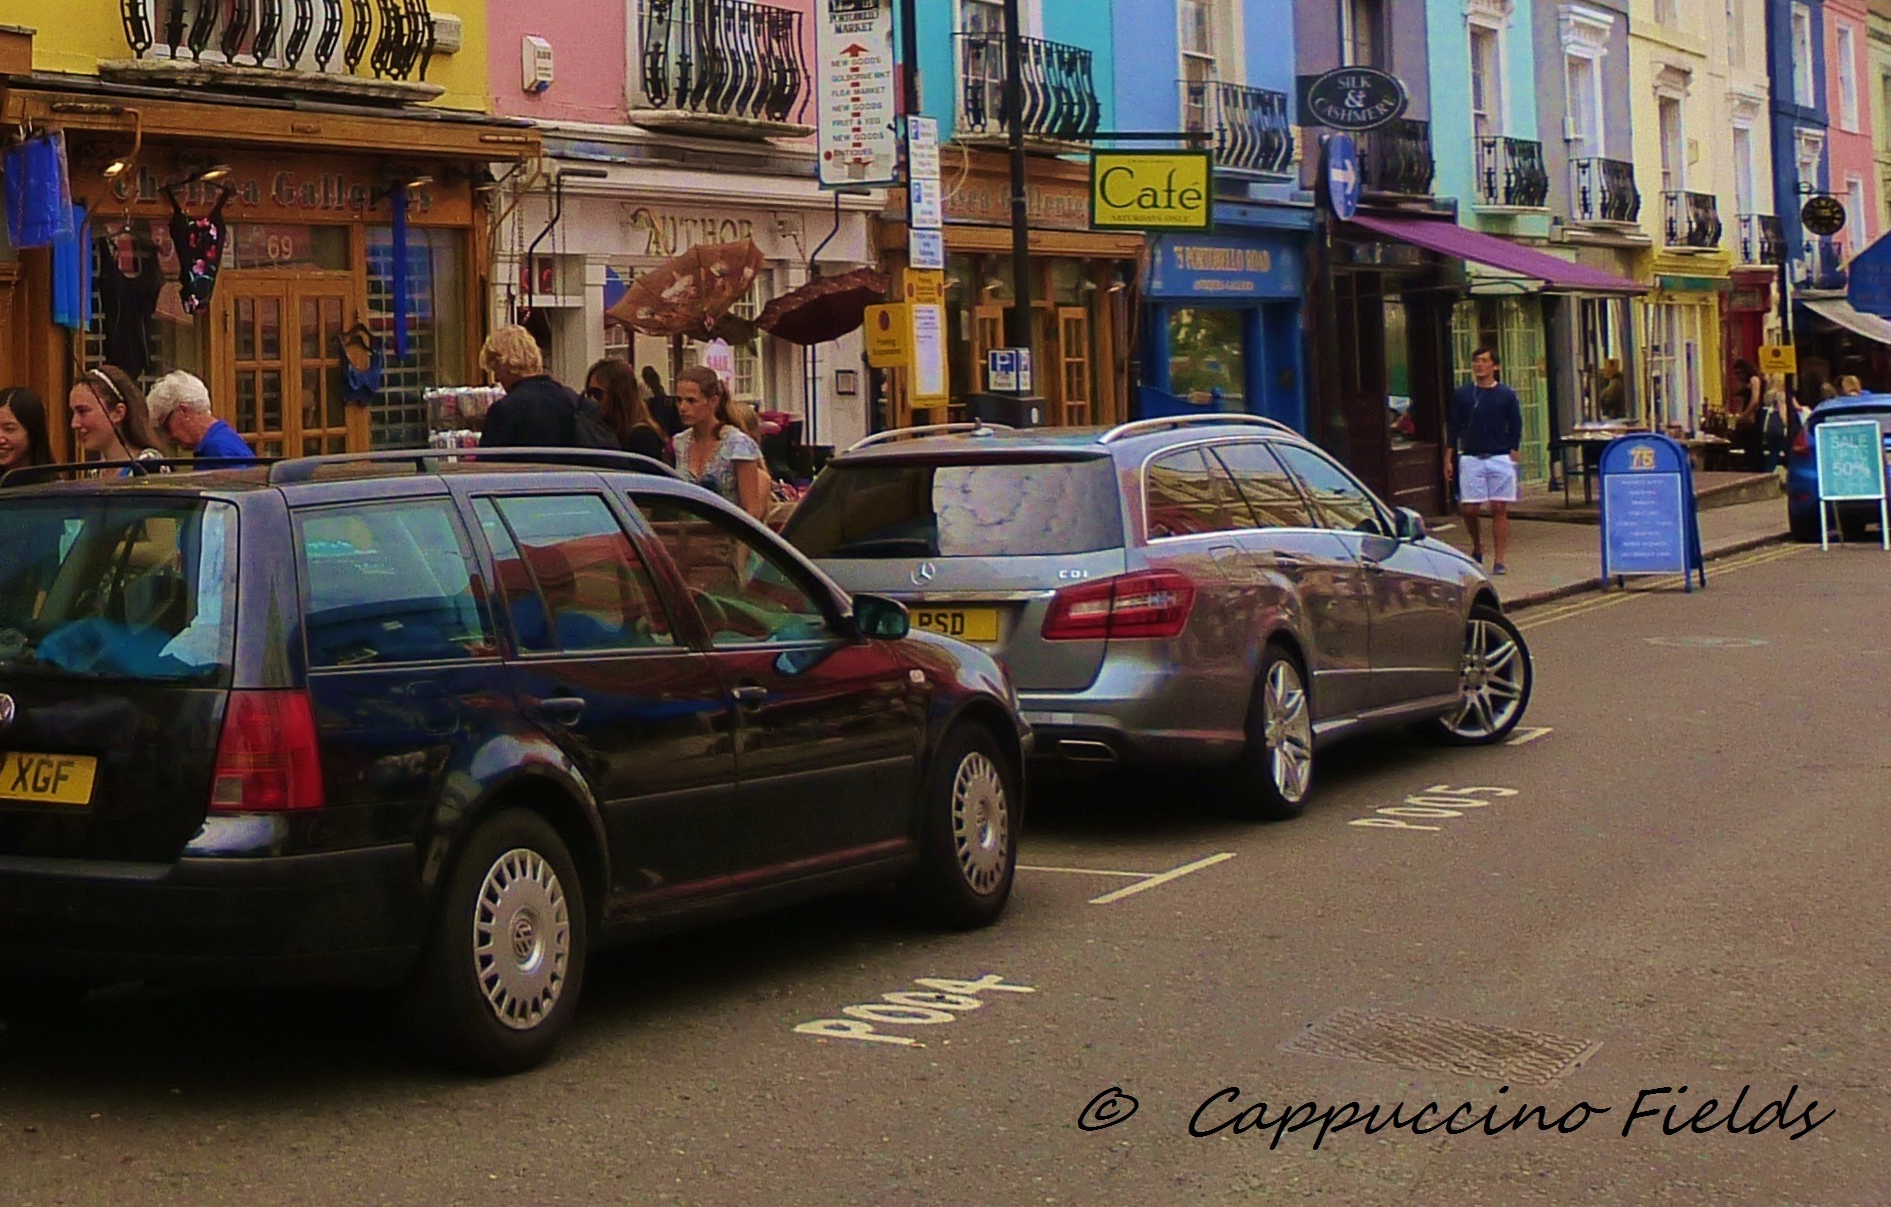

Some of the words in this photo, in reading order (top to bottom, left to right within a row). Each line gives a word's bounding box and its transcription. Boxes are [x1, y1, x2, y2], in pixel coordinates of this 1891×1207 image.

[828, 10, 879, 23] PORTOBELLO
[834, 22, 874, 33] MARKET
[851, 56, 881, 65] GOODS
[1337, 75, 1372, 90] SILK
[853, 86, 885, 95] MARKET
[852, 101, 883, 110] GOODS
[1345, 90, 1366, 108] &
[1314, 94, 1396, 123] CASHMERE
[853, 131, 884, 140] GOODS
[1098, 165, 1203, 211] Café
[266, 234, 293, 260] 69
[1831, 435, 1868, 448] SALE
[1058, 569, 1088, 579] CDI
[11, 756, 75, 794] XGF
[1348, 784, 1519, 830] P005
[793, 974, 1037, 1047] P004
